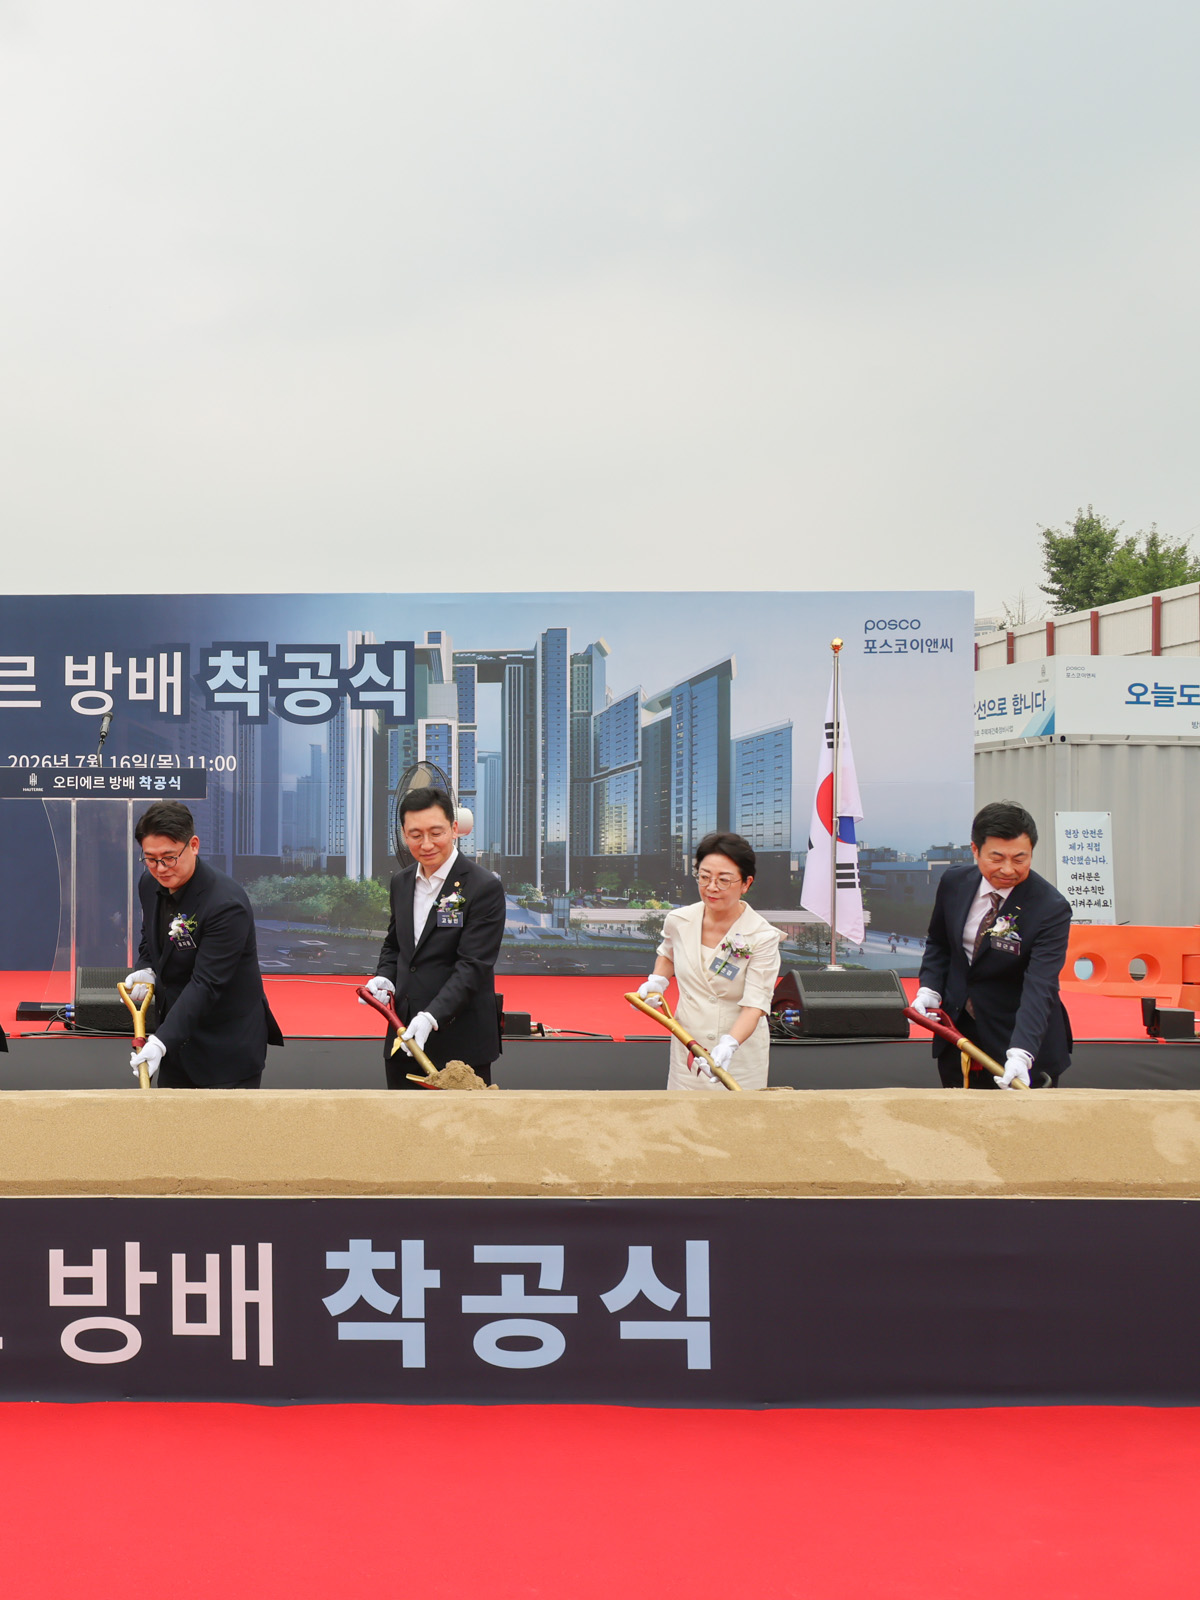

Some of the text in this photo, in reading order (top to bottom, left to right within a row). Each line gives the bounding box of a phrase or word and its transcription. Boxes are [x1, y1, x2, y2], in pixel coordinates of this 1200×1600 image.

[864, 618, 921, 634] posco
[863, 637, 953, 654] 포스코이앤씨
[64, 651, 182, 716] 방배
[206, 649, 407, 718] 착공식
[1124, 682, 1200, 708] 오늘도
[974, 689, 1047, 720] 선으로 합니다
[7, 753, 69, 768] 2026년
[187, 755, 237, 772] 11:00
[53, 775, 181, 791] 오티에르 방배 착공식
[1065, 829, 1104, 839] 현장 안전은
[1068, 842, 1101, 852] 제가 직접
[1062, 855, 1108, 865] 확인했습니다.
[1070, 872, 1101, 882] 여러분은
[1067, 885, 1105, 895] 안전수칙만
[1070, 899, 1113, 908] 지켜주세요!
[48, 1241, 274, 1367] 방배
[321, 1238, 712, 1370] 착공식
